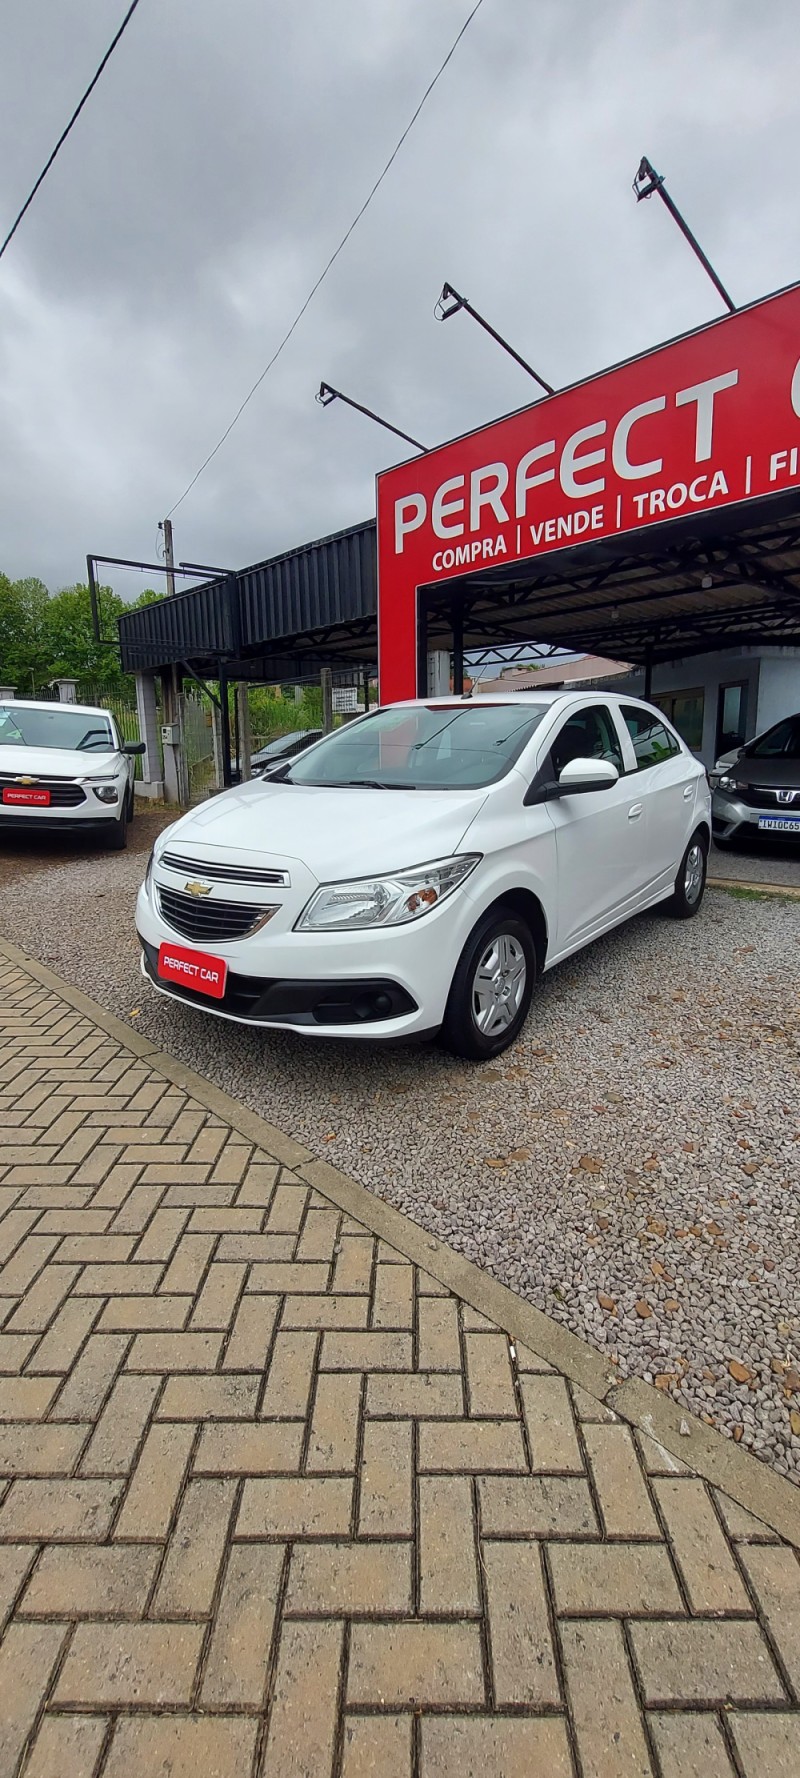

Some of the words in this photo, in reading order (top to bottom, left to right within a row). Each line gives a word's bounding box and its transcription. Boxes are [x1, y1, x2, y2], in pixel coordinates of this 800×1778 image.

[394, 369, 738, 554] PERFECT
[432, 534, 507, 571] COMPRA
[529, 505, 604, 545] VENDE
[633, 471, 728, 518] TROCA
[163, 956, 199, 976] PERFECT
[200, 968, 219, 983] CAR
